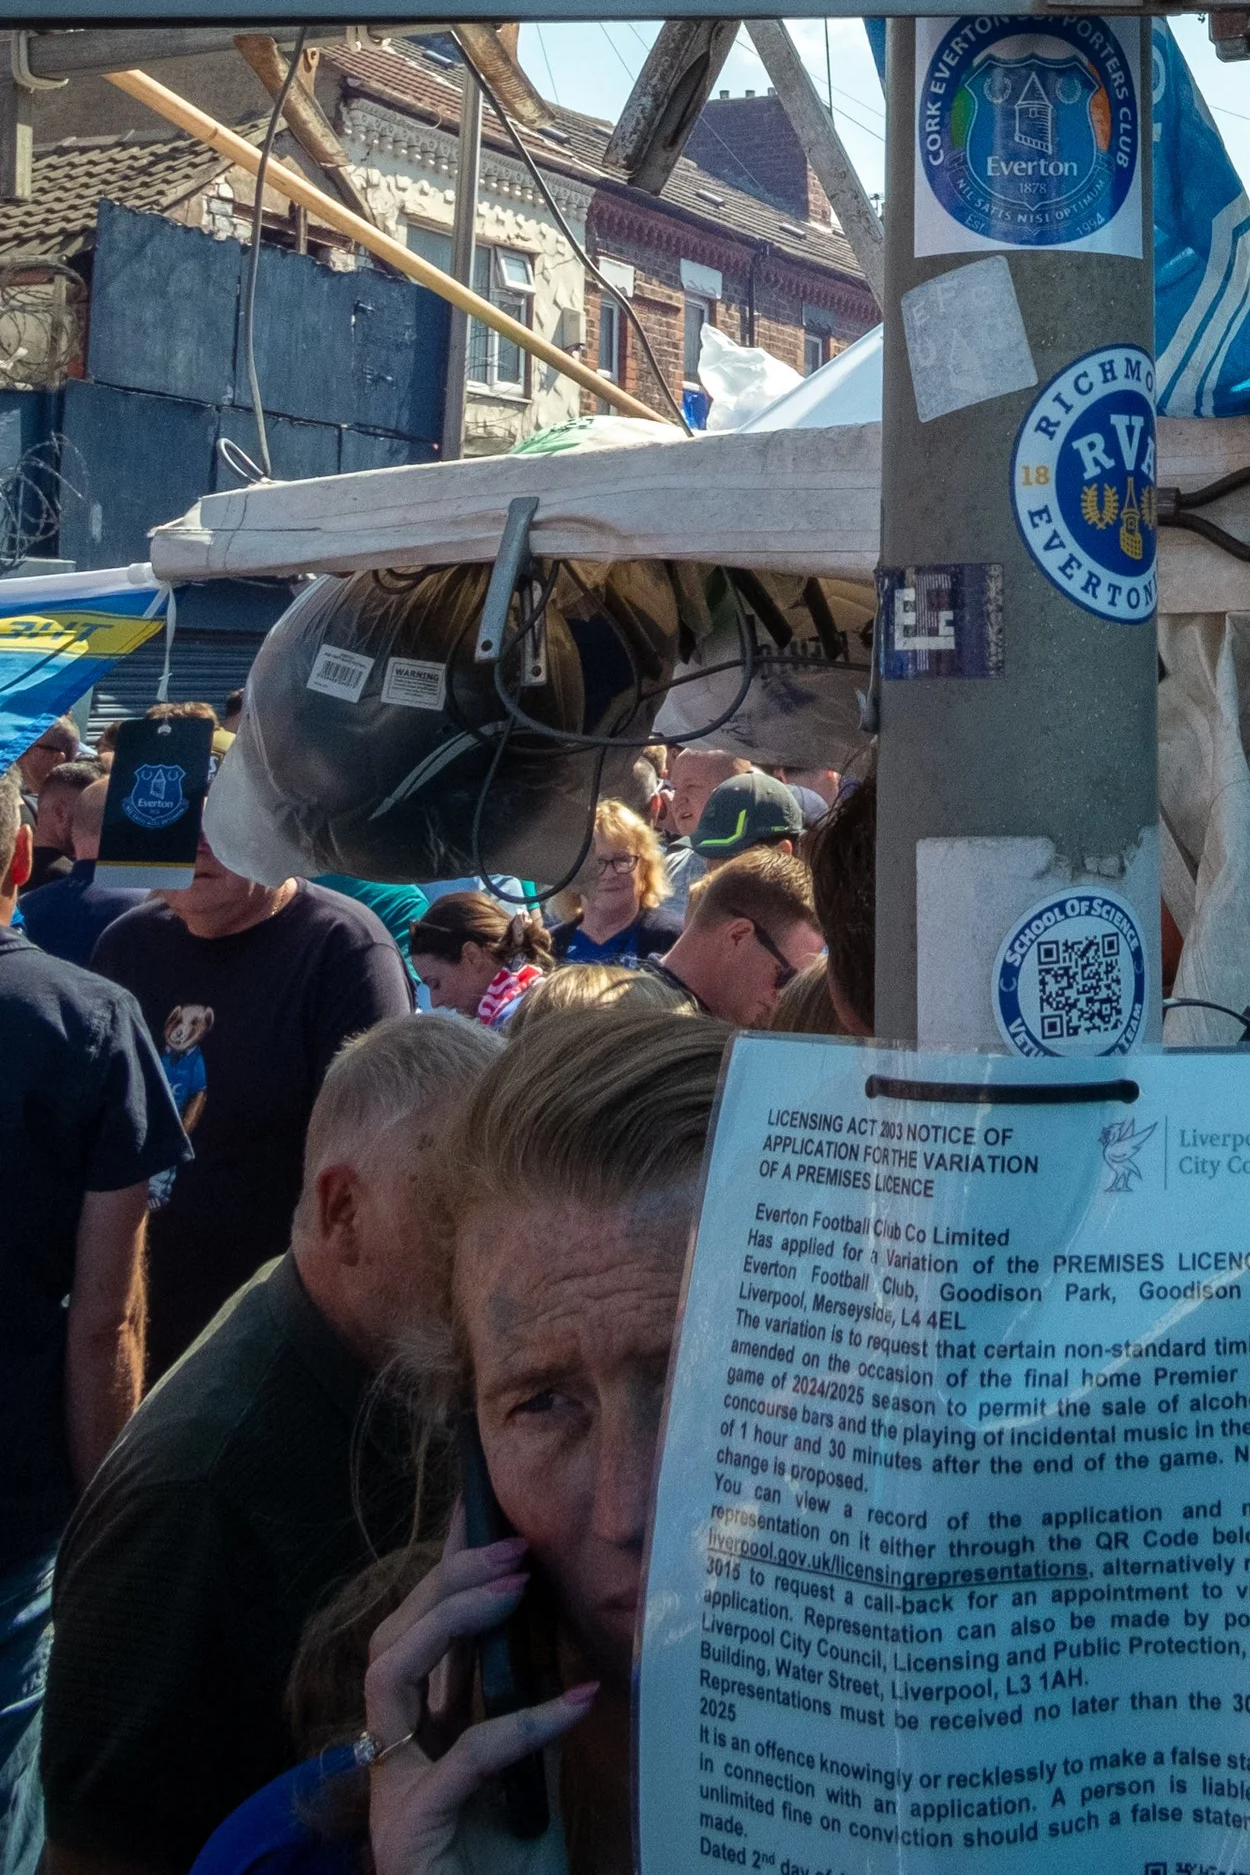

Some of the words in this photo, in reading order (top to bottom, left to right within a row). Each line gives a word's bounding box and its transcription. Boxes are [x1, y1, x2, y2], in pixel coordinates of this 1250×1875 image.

[925, 100, 945, 167] CORK
[1115, 106, 1133, 169] CLUB
[986, 156, 1078, 177] Everton
[957, 177, 976, 201] NIL
[974, 197, 1012, 221] SATIS
[1016, 212, 1050, 224] NISI
[1055, 179, 1106, 220] OPTIMUM
[1019, 182, 1048, 194] 1878
[1075, 212, 1106, 236] 1994
[1021, 465, 1050, 487] 18
[394, 667, 440, 682] WARNING
[138, 798, 174, 809] Everton
[1005, 907, 1066, 967] SCHOOL
[1091, 898, 1139, 952] SCIENCE
[767, 1108, 844, 1134] LICENSING
[847, 1116, 877, 1137] ACT
[907, 1123, 975, 1146] NOTICE
[983, 1127, 1014, 1147] OF
[762, 1134, 860, 1163] APPLICATION
[863, 1145, 890, 1167] FOR
[890, 1148, 918, 1170] THE
[923, 1152, 1039, 1175] VARIATION
[1178, 1155, 1221, 1179] City
[758, 1159, 779, 1179] OF
[781, 1163, 793, 1182] A
[796, 1164, 871, 1191] PREMISES
[874, 1175, 935, 1198] LICENCE
[755, 1202, 809, 1228] Everton
[812, 1210, 870, 1236] Football
[873, 1219, 902, 1241] Club
[904, 1225, 927, 1244] Co
[933, 1226, 1011, 1248] Limited
[747, 1228, 773, 1249] Has
[780, 1235, 835, 1261] applied
[842, 1242, 863, 1263] for
[870, 1251, 879, 1266] a
[886, 1249, 959, 1276] Variation
[972, 1255, 996, 1276] of
[1006, 1255, 1040, 1275] the
[1053, 1252, 1165, 1275] PREMISES
[743, 1255, 797, 1281] Everton
[810, 1265, 870, 1293] Football
[882, 1276, 920, 1304] Club,
[940, 1281, 1042, 1303] Goodison
[1064, 1282, 1118, 1306] Park,
[1138, 1280, 1242, 1301] Goodison
[738, 1281, 808, 1313] Liverpool,
[811, 1293, 896, 1329] Merseyside,
[901, 1307, 922, 1328] L4
[926, 1310, 968, 1331] 4EL
[700, 1639, 772, 1678] Building,
[775, 1655, 824, 1686] Water
[828, 1668, 885, 1702] Street,
[890, 1676, 1000, 1706] Liverpool,
[1005, 1673, 1032, 1697] L3
[1038, 1666, 1090, 1692] 1AH.
